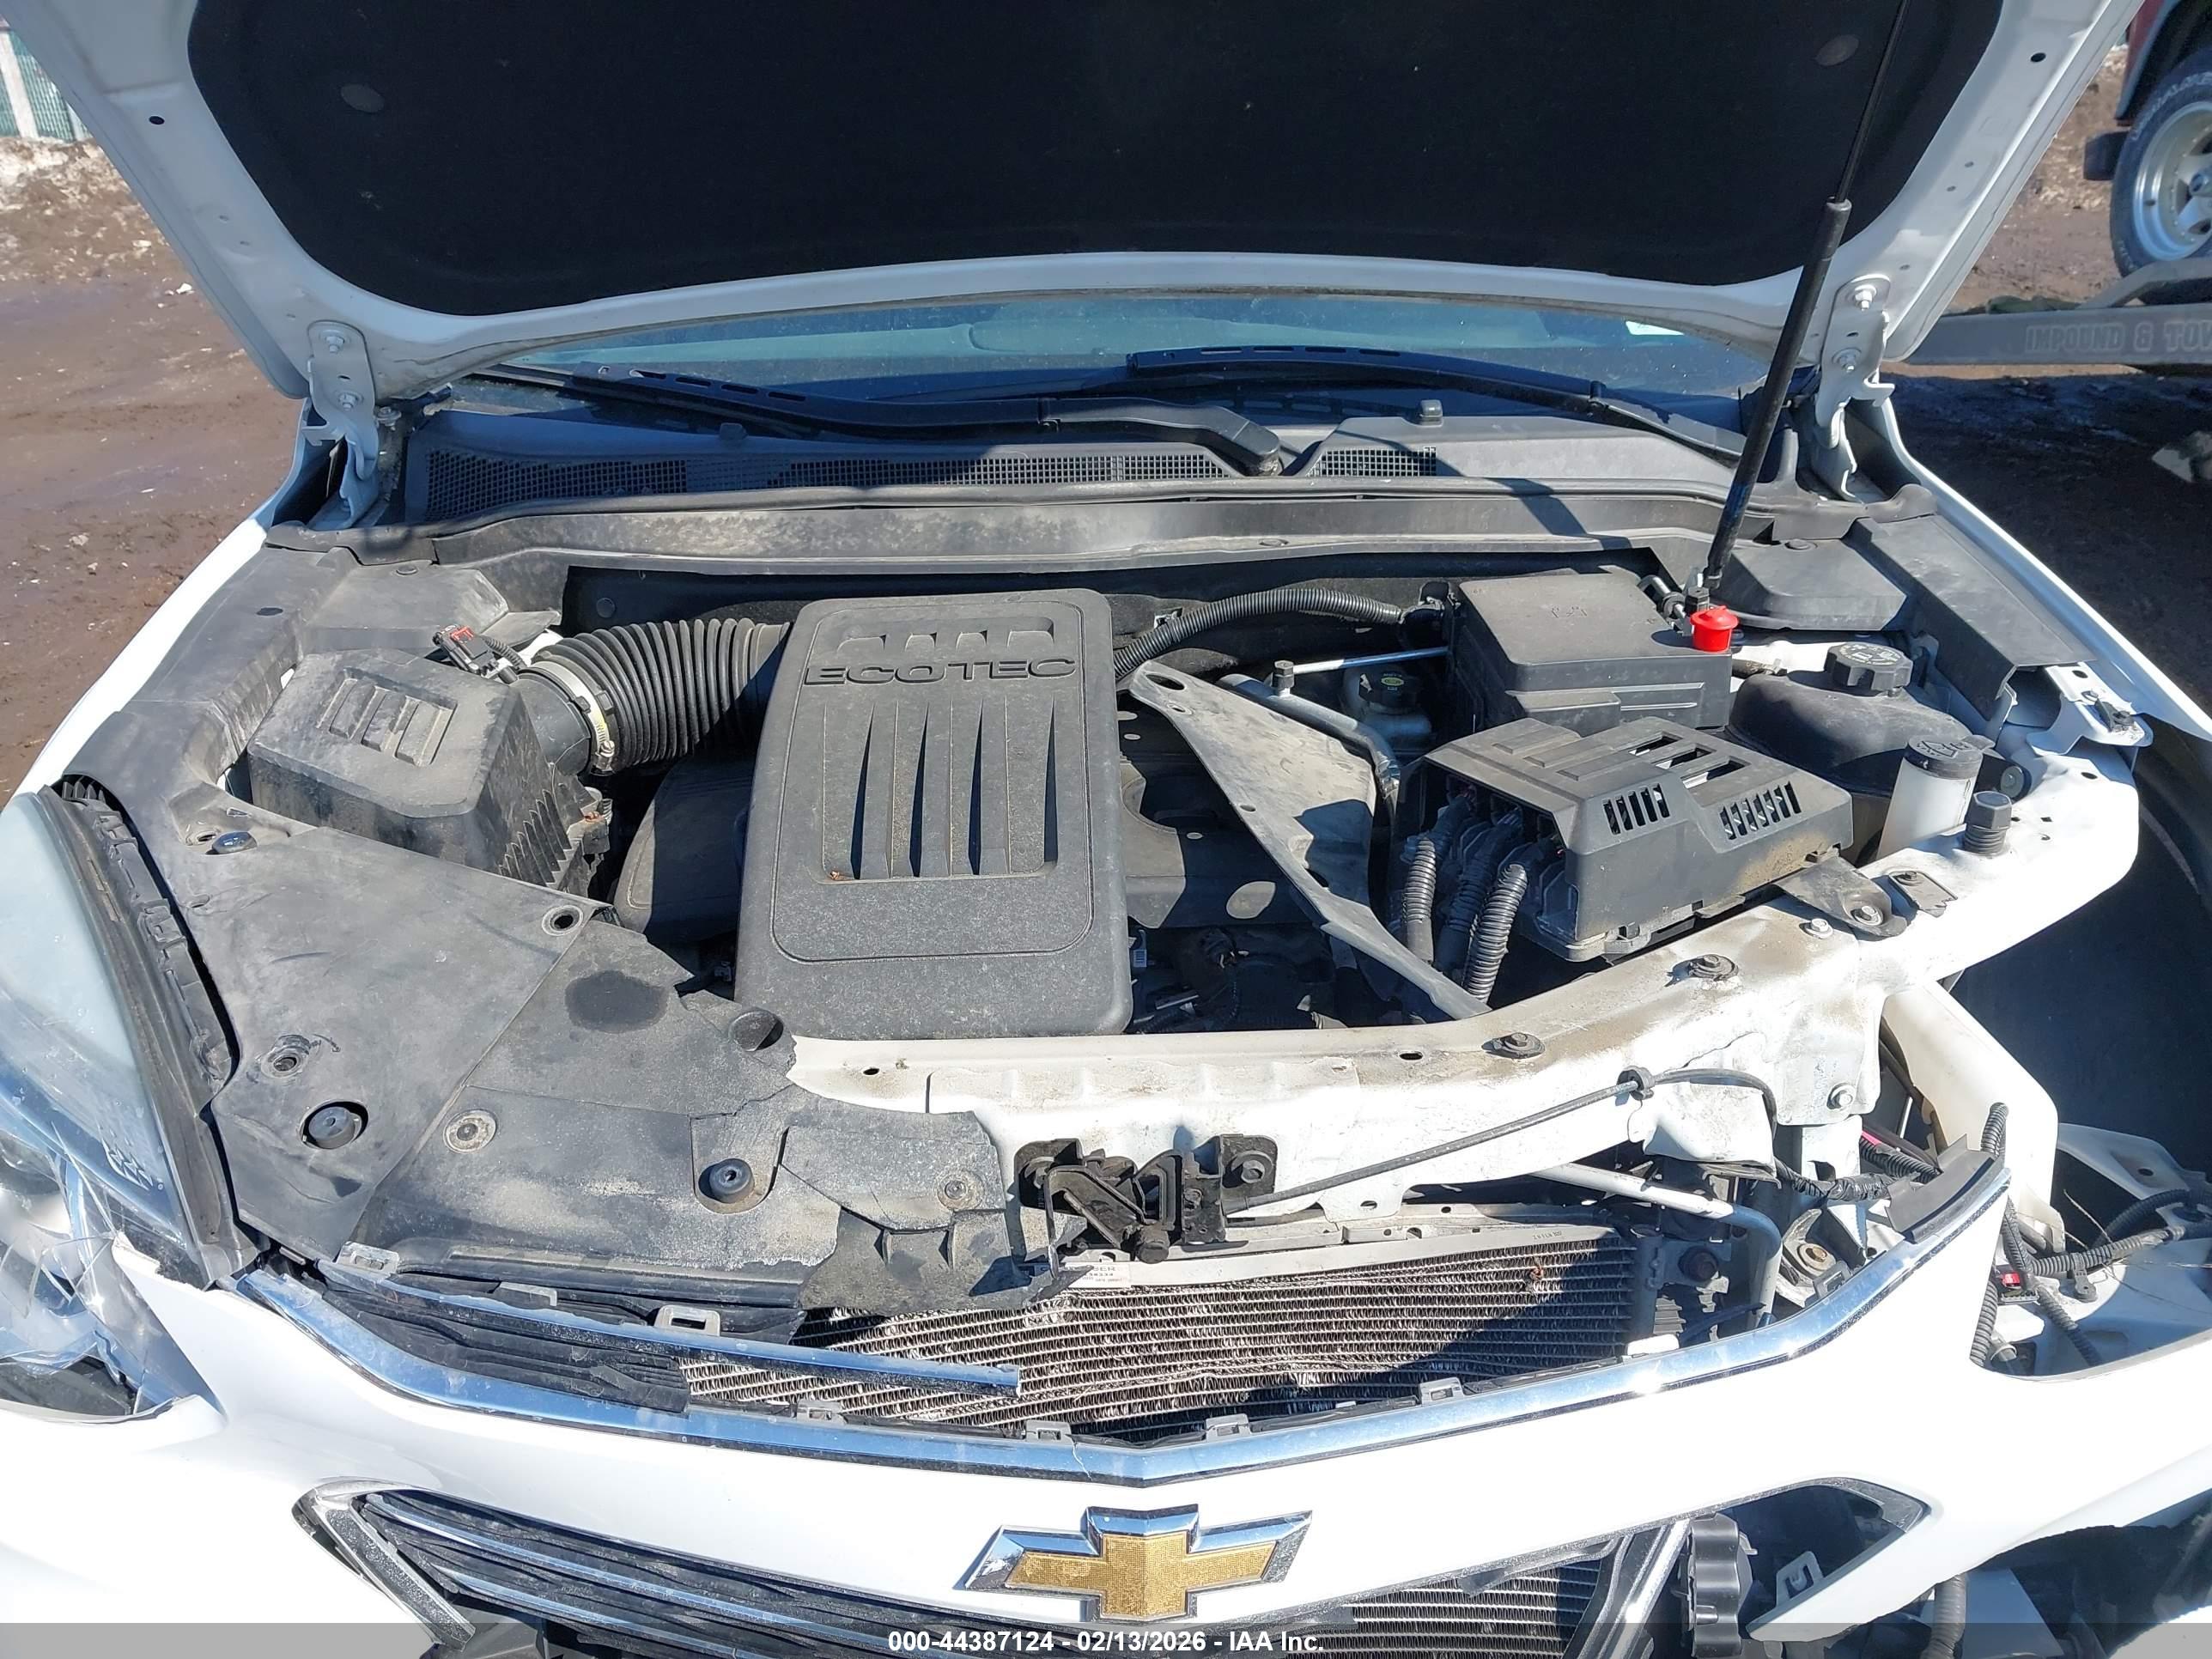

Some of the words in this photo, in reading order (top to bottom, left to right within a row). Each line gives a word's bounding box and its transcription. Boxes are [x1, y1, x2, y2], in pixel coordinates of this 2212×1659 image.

[2026, 322, 2126, 352] IMPOUND
[2134, 320, 2154, 352] &
[804, 658, 1077, 685] ECOTEC
